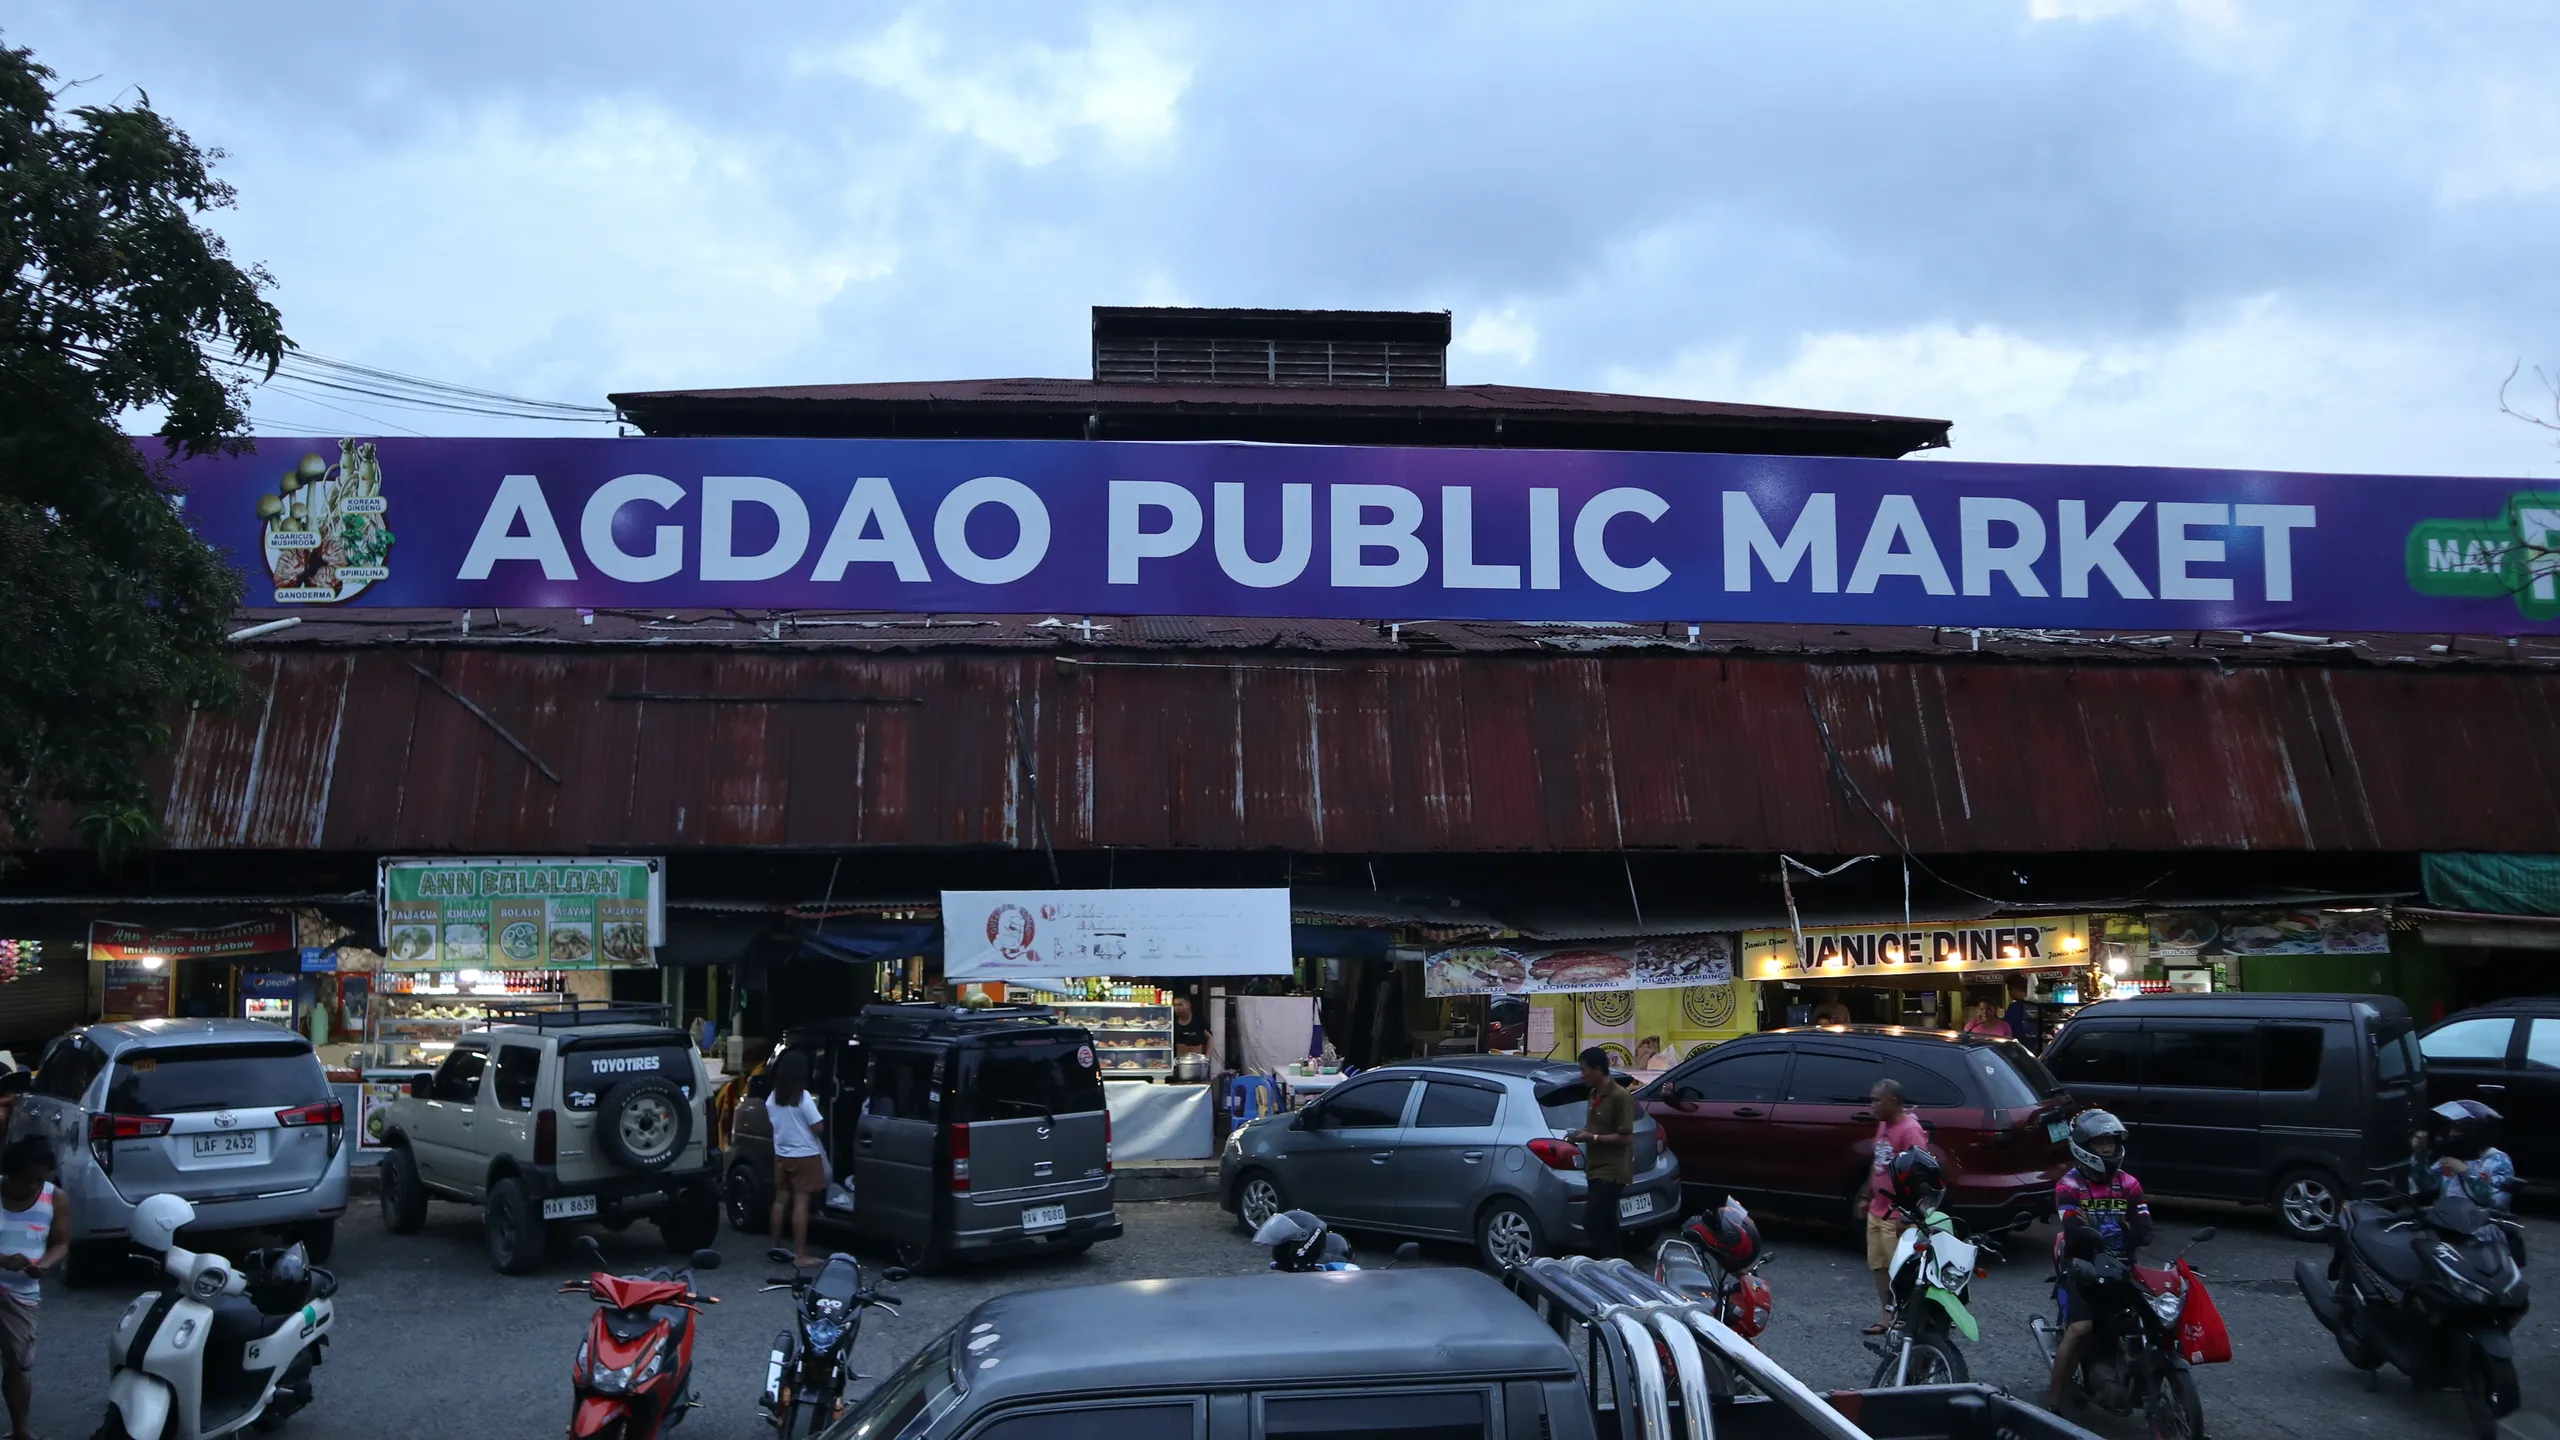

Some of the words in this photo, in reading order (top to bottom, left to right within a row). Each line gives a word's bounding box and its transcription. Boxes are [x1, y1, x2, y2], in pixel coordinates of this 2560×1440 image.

[457, 474, 1050, 586] AGDAO
[1108, 480, 1671, 592] PUBLIC
[1723, 490, 2316, 602] MARKET
[2427, 539, 2511, 574] MAY
[340, 568, 385, 577] SPIRULINA
[277, 591, 332, 599] GANODERMA
[418, 870, 475, 897] ANN
[481, 869, 620, 896] BOLALOAN
[391, 910, 438, 920] BALBACUA
[447, 908, 487, 919] KINILAW
[500, 908, 541, 918] BOLALO
[124, 944, 145, 954] Init
[189, 942, 212, 955] ang
[215, 940, 255, 953] Sabaw
[1744, 940, 1767, 951] Janice
[1802, 931, 1924, 969] JANICE
[1932, 926, 2041, 963] DINER
[2161, 948, 2197, 956] BULALO
[1641, 974, 1681, 983] KILAWIN
[1682, 971, 1725, 981] KAMBING
[266, 978, 290, 988] pepsi
[1537, 983, 1578, 991] LECHON
[1580, 981, 1620, 990] KAWALI
[196, 1140, 217, 1152] LAF
[225, 1137, 254, 1150] 2432
[571, 1196, 597, 1213] 8639
[816, 1297, 843, 1308] EVO
